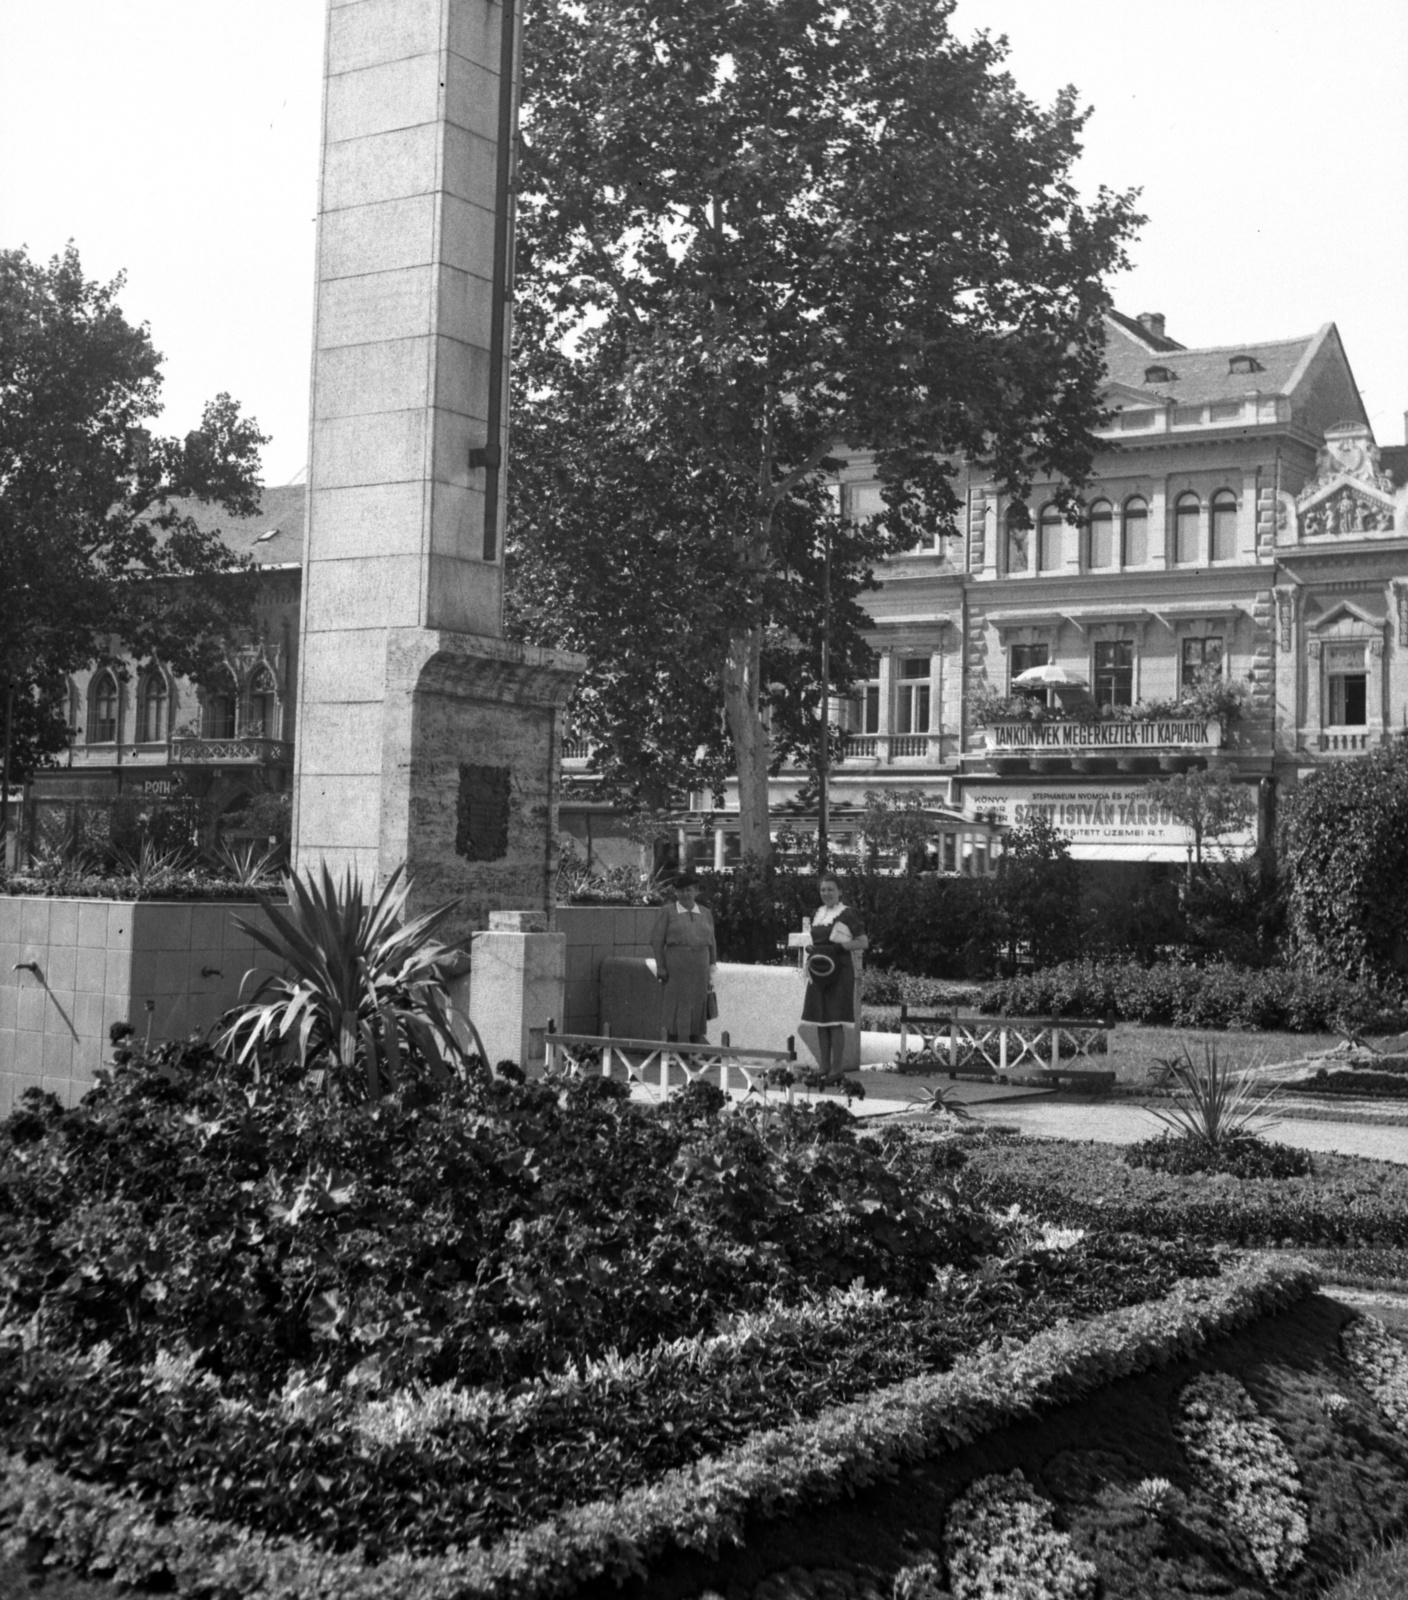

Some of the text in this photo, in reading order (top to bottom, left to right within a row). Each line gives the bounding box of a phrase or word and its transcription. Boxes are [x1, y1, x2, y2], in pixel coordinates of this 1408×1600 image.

[974, 795, 1008, 803] KÖNYV
[1112, 791, 1122, 800] ÉS
[1014, 804, 1056, 824] SZENT
[1060, 799, 1114, 825] ISTVÁN
